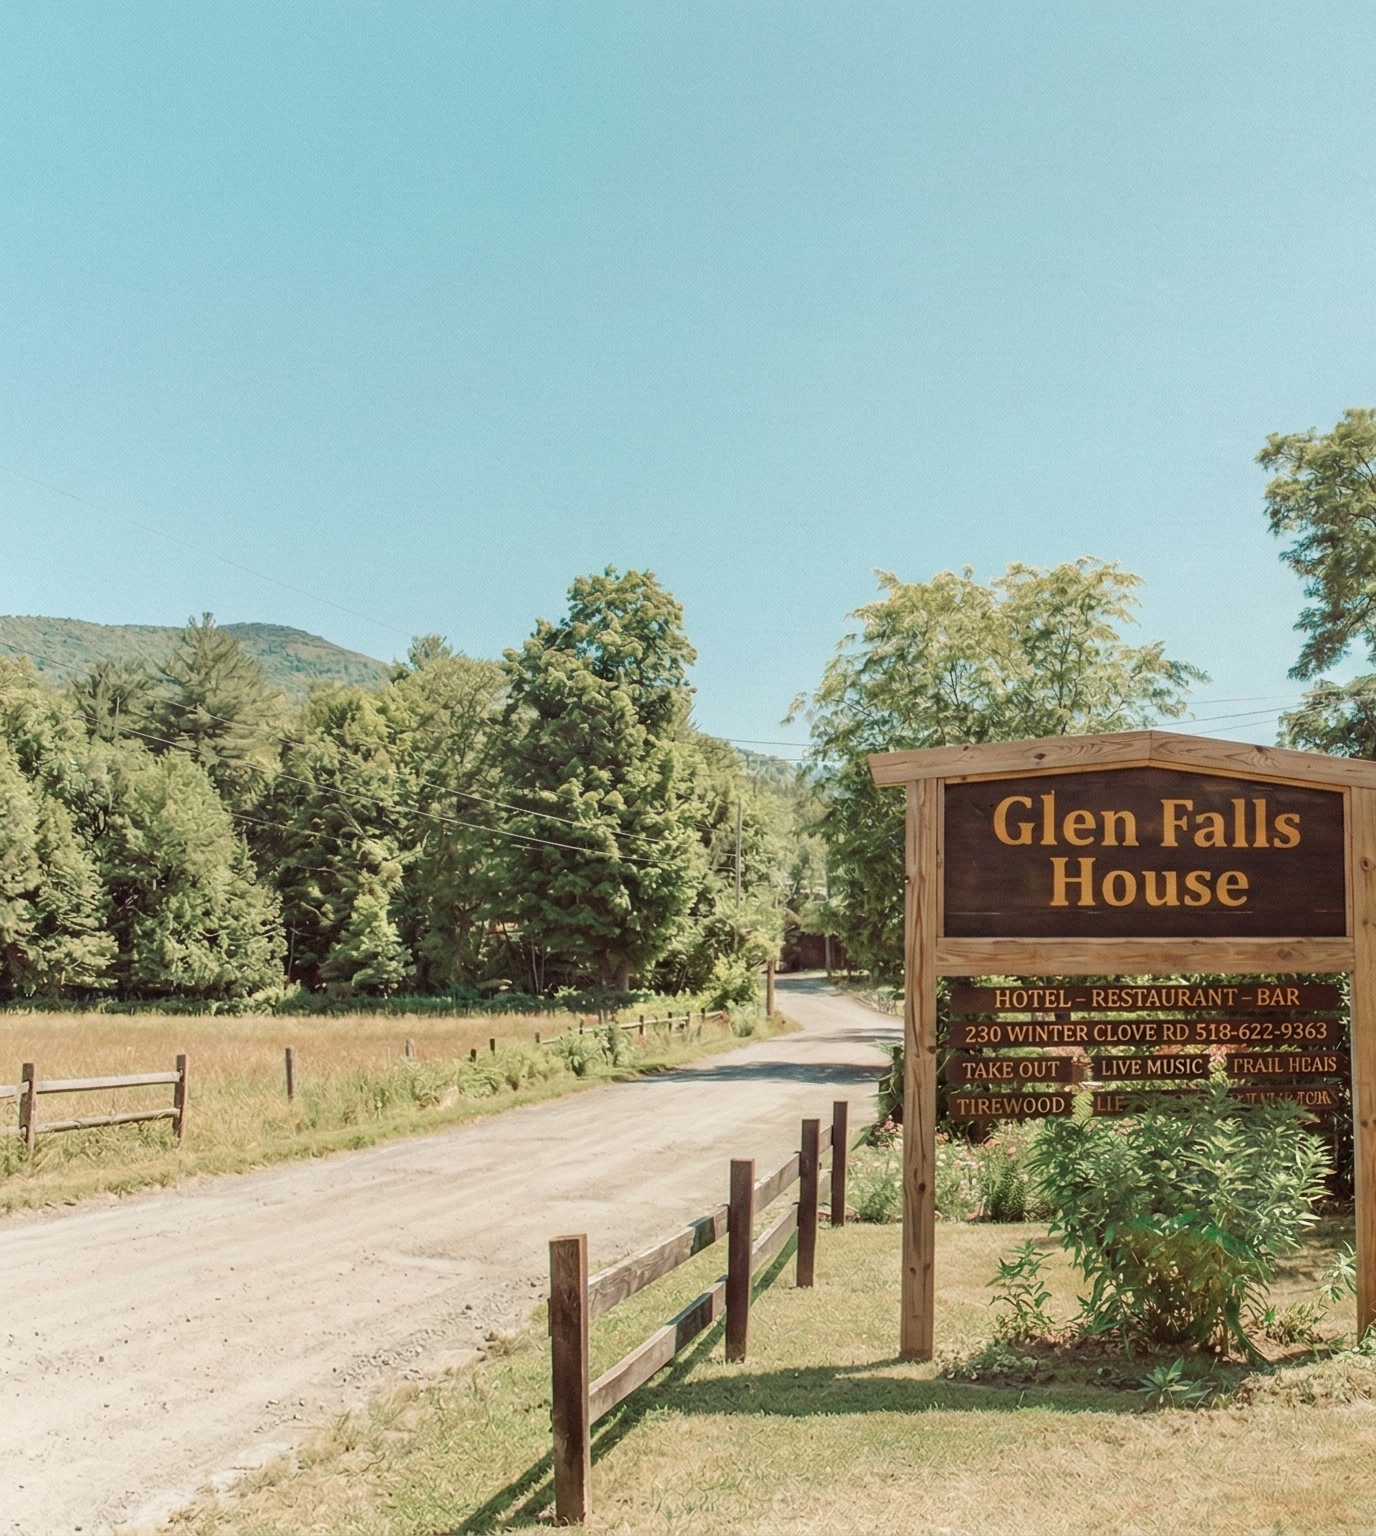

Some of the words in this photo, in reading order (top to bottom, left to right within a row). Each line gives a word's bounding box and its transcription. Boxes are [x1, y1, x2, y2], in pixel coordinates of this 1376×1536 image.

[993, 791, 1140, 846] Glen
[1160, 798, 1301, 849] Falls
[1049, 857, 1250, 907] House
[994, 990, 1072, 1008] HOTEL
[1091, 988, 1239, 1007] RESTAURANT
[1257, 988, 1301, 1006] BAR
[965, 1026, 1001, 1043] 230
[1006, 1025, 1088, 1042] WINTER
[1093, 1024, 1157, 1041] CLOVE
[1162, 1024, 1189, 1041] RD
[1195, 1023, 1327, 1040] 518-622-9363
[962, 1062, 1014, 1079] TAKE
[1019, 1061, 1060, 1077] OUT
[1101, 1060, 1142, 1076] LIVE
[1147, 1058, 1203, 1075] MUSIC
